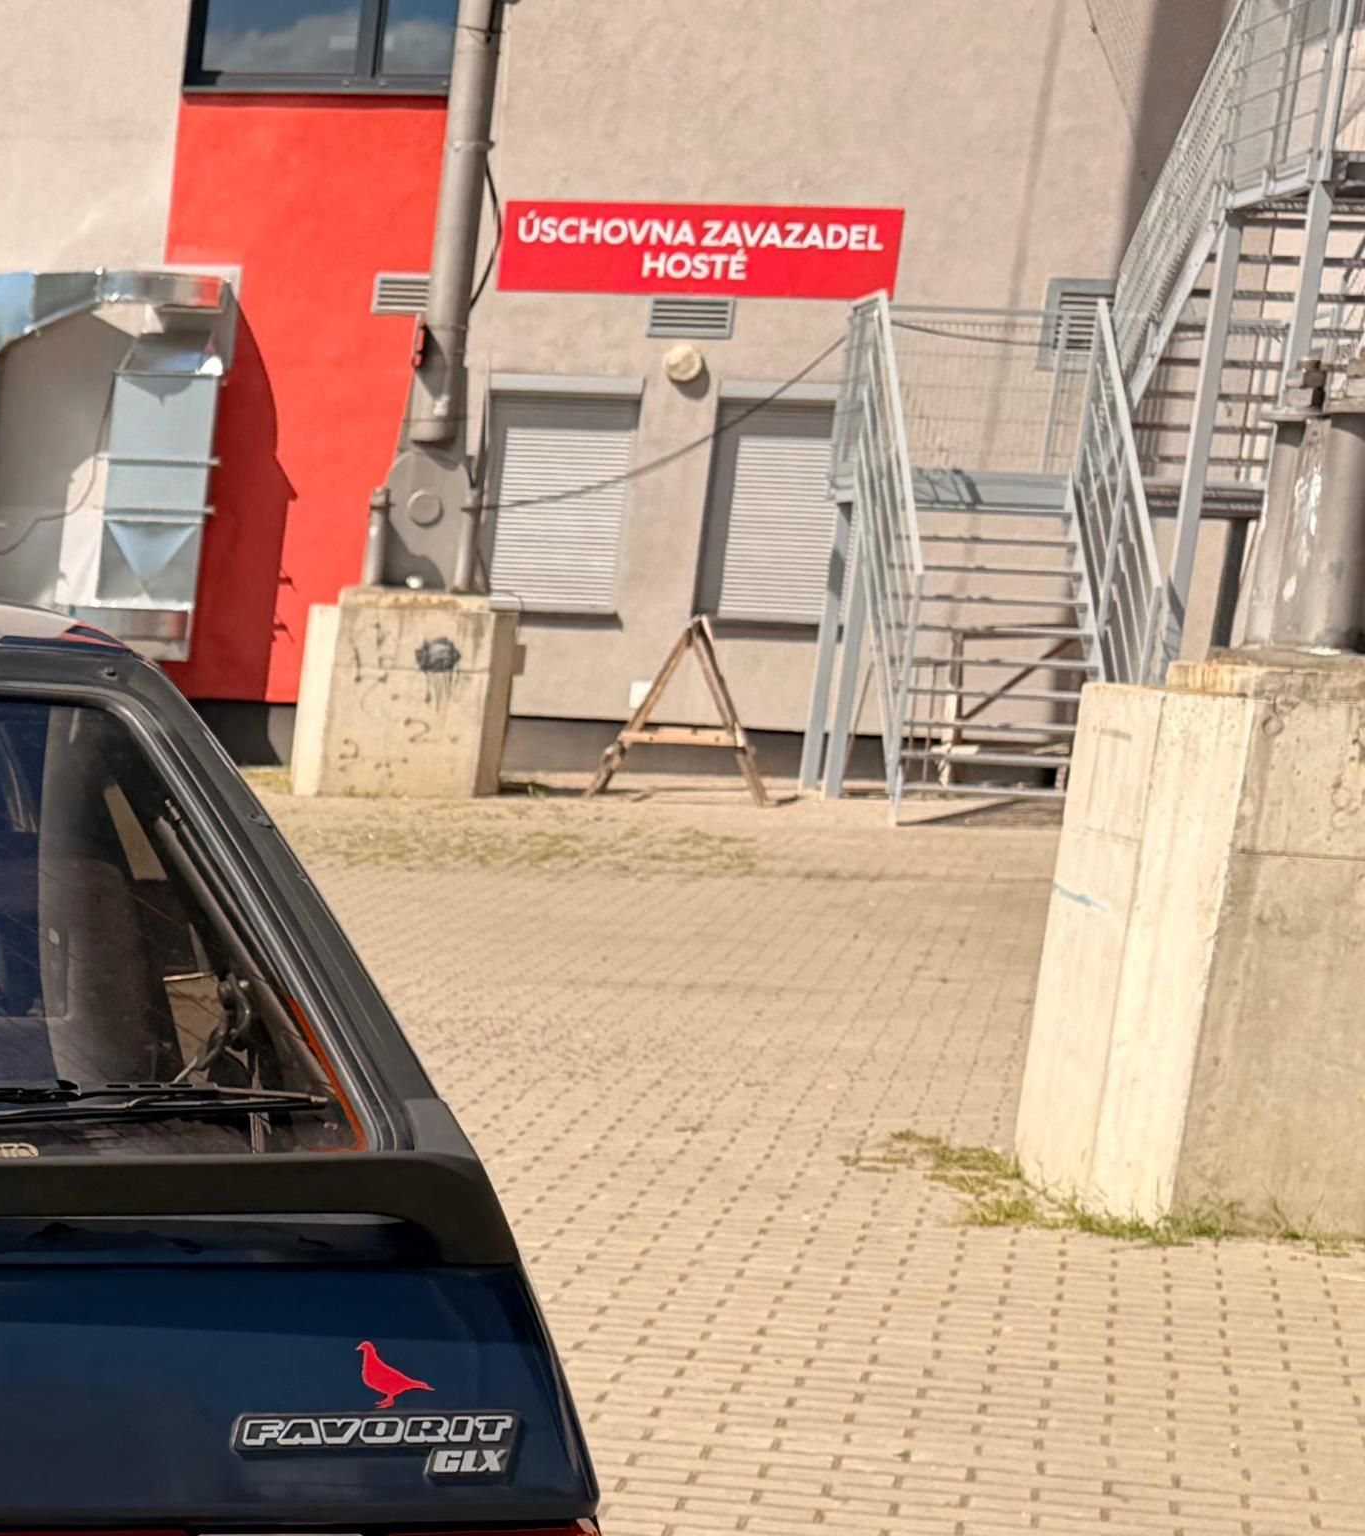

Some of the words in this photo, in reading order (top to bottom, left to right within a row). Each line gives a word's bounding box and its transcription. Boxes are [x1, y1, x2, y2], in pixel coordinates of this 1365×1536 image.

[517, 209, 696, 246] ÚSCHOVNA
[700, 219, 884, 252] ZAVAZADEL
[641, 248, 749, 281] HOSTÉ
[241, 1415, 513, 1446] FAVORIT
[433, 1449, 507, 1473] GLX
